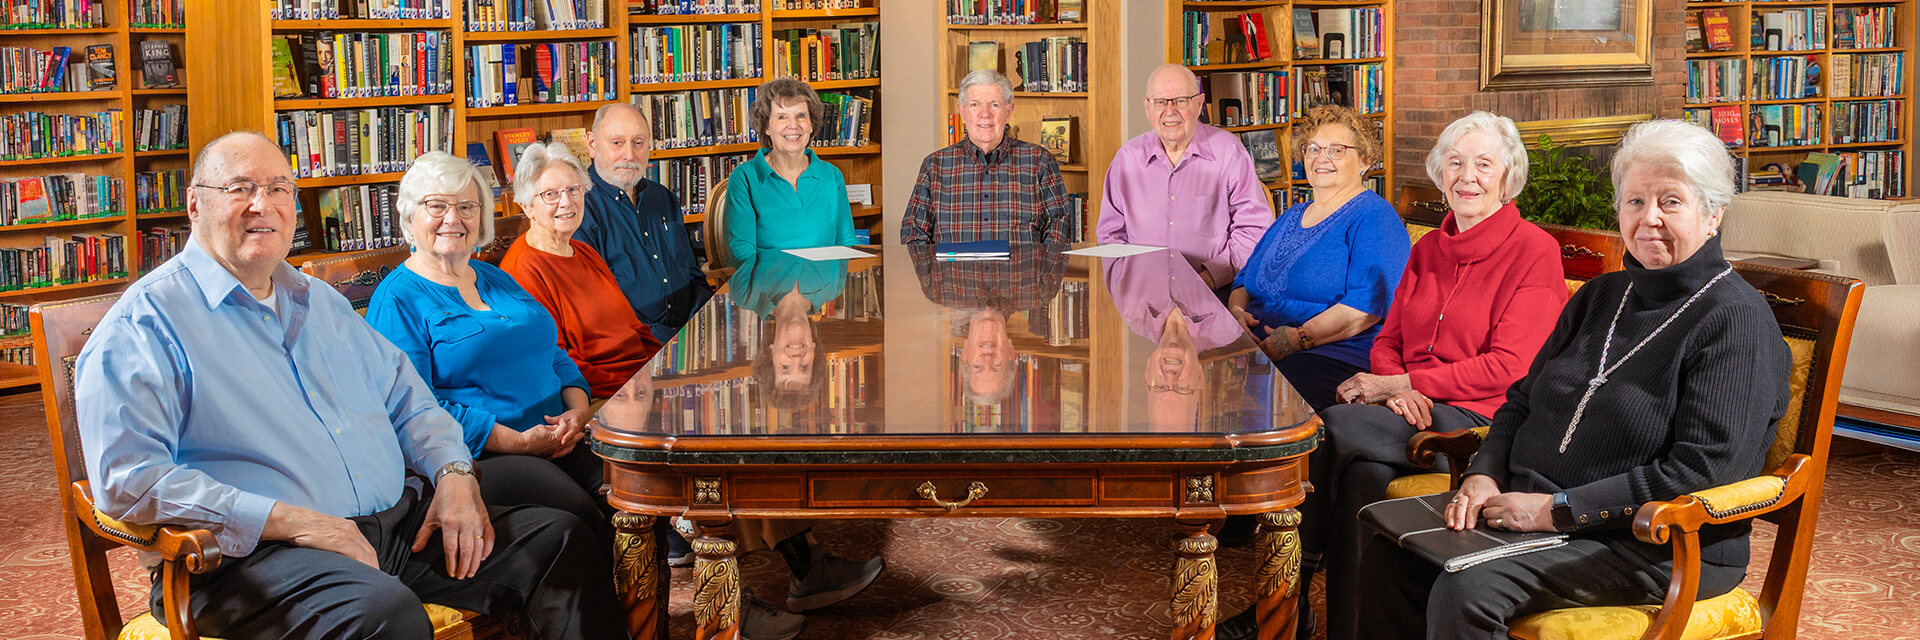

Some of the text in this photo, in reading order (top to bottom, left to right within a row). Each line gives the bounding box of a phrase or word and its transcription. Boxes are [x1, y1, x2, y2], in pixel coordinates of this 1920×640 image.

[350, 124, 358, 155] CHURCHILL
[1252, 142, 1276, 151] GREG
[381, 189, 389, 219] COOLIDGE
